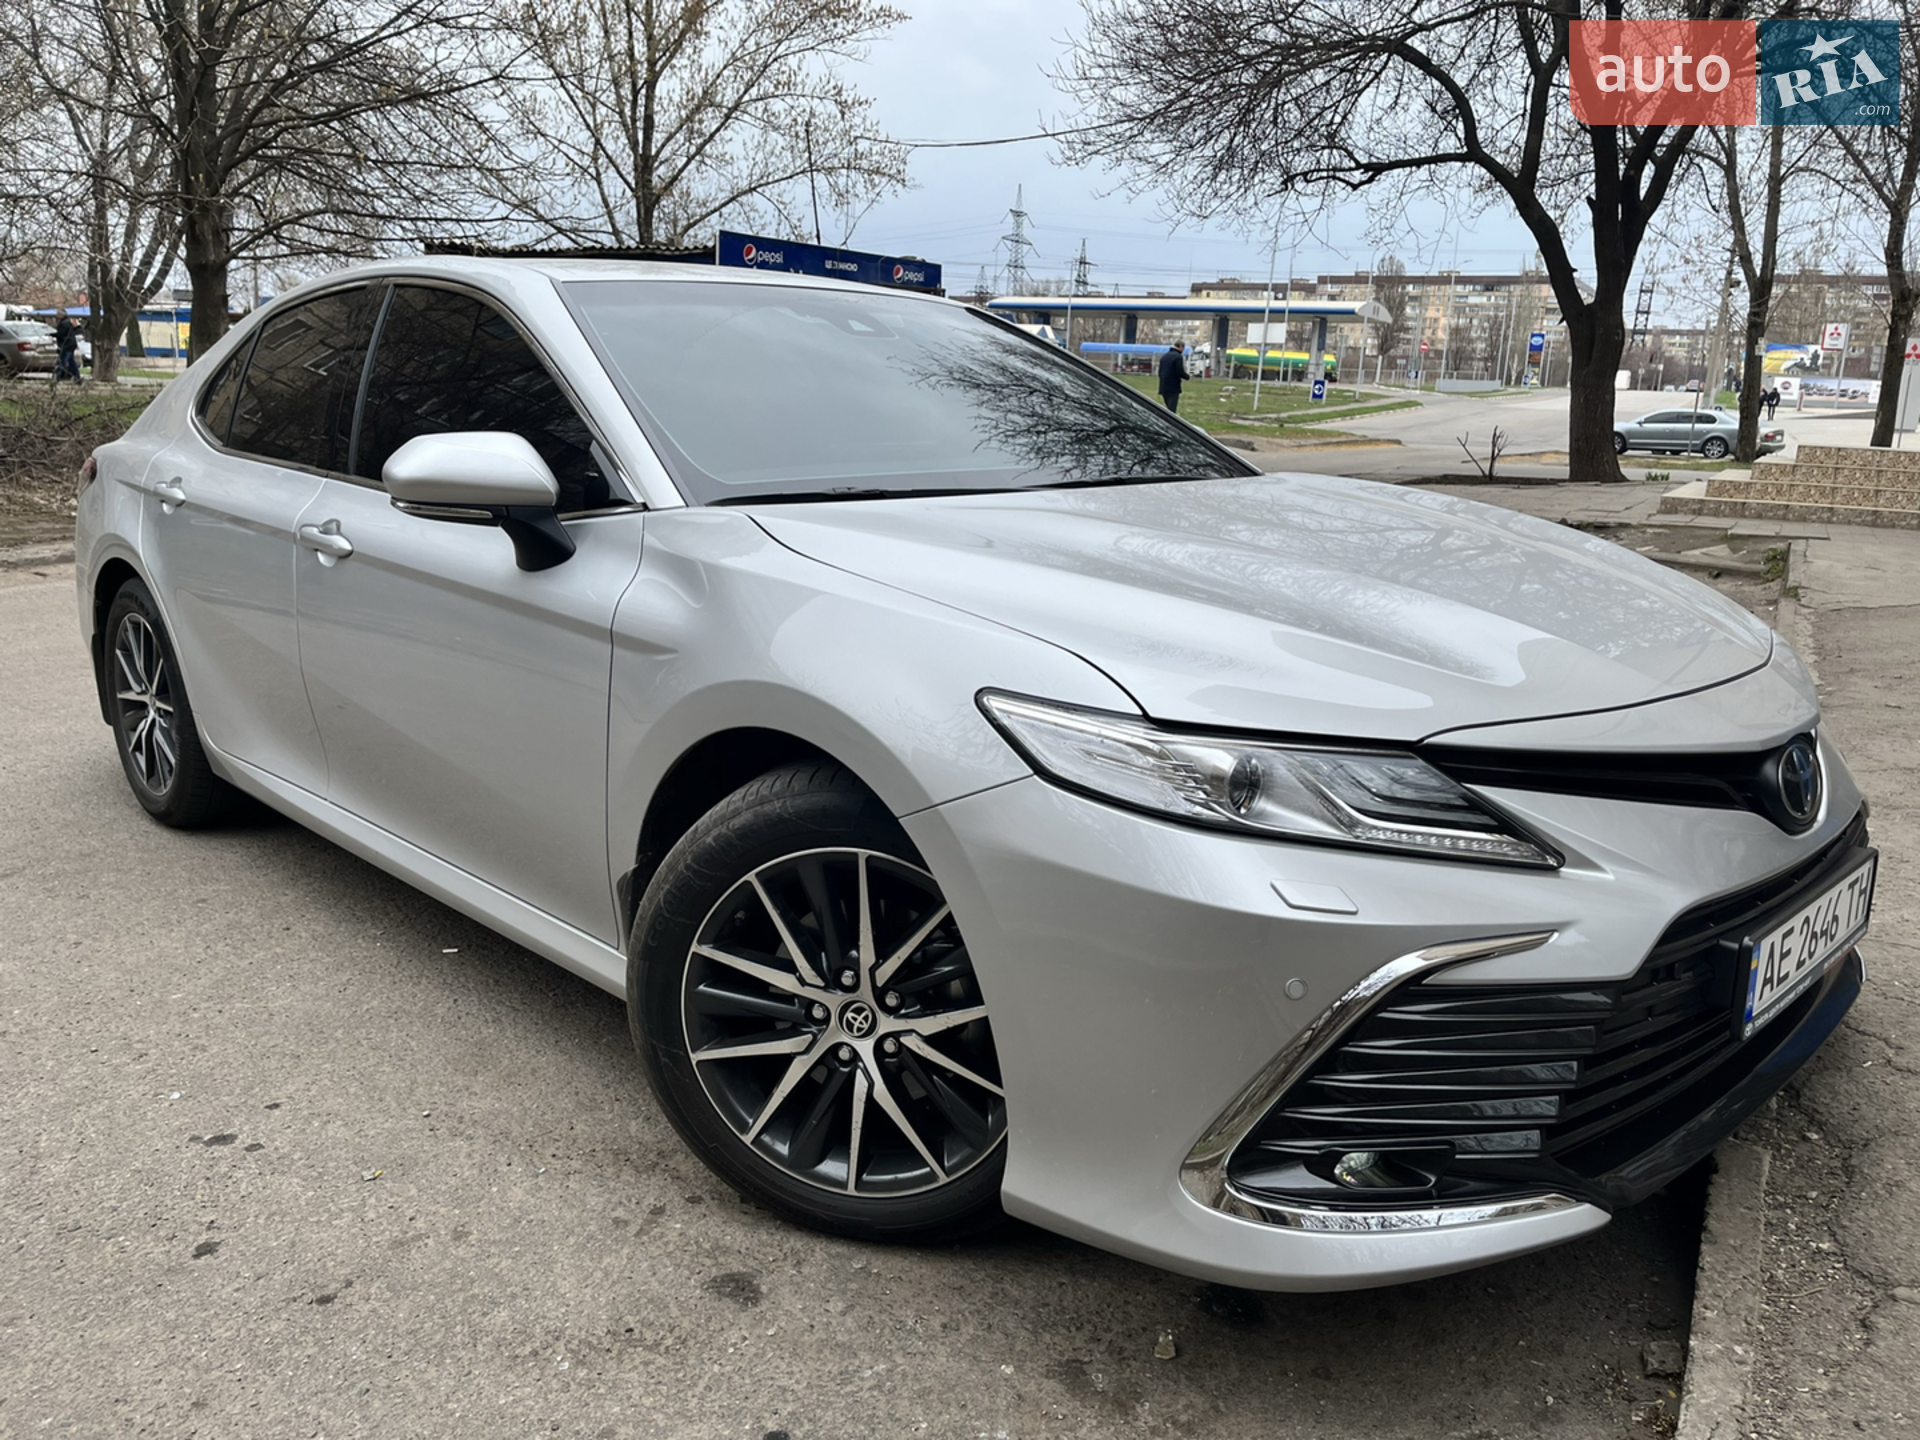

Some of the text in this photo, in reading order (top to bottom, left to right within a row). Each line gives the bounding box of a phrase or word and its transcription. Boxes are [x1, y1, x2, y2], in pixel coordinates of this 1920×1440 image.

[757, 250, 784, 265] pepsi
[903, 270, 925, 284] pepsi
[1759, 925, 1795, 1002] AE
[1795, 889, 1843, 972] 2646
[1846, 866, 1872, 930] TH
